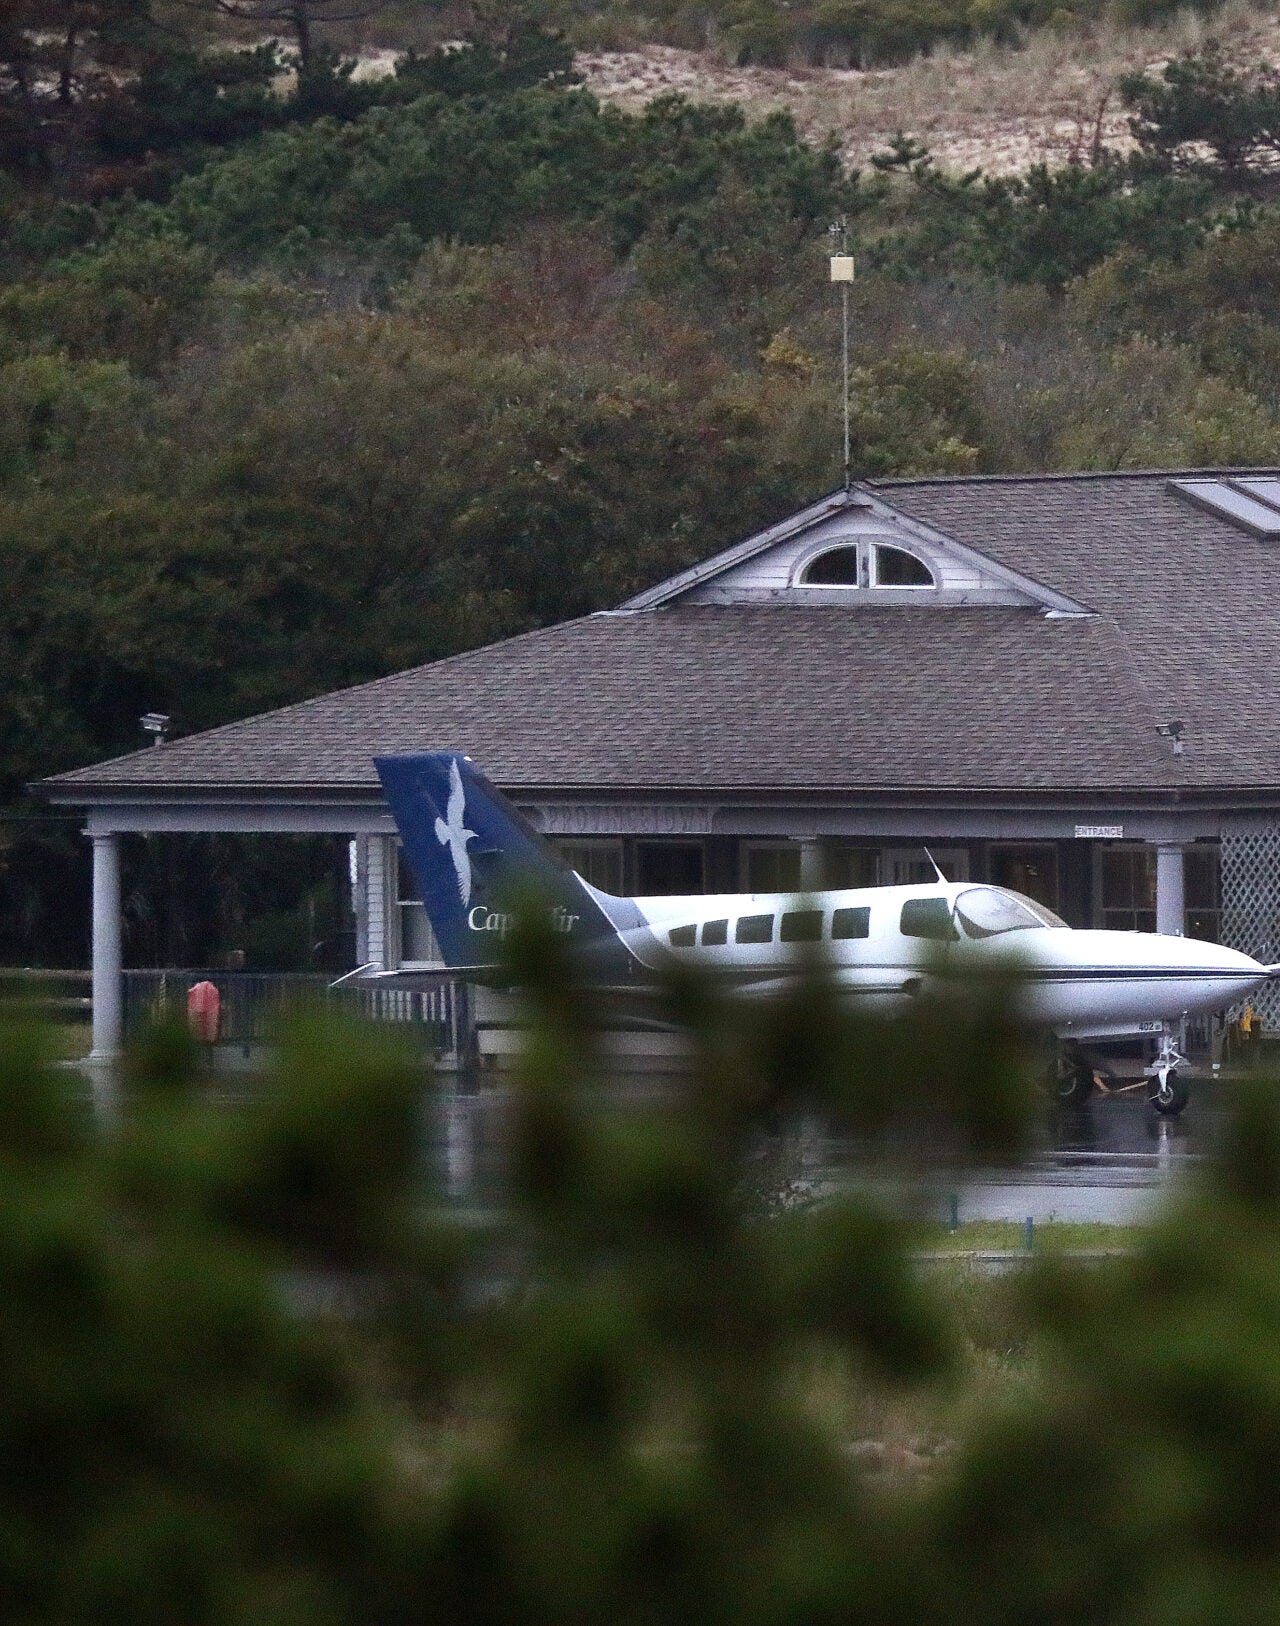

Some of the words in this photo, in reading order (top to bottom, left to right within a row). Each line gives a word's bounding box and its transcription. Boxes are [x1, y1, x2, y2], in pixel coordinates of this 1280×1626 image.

[1075, 827, 1122, 836] ENTRANCE
[468, 906, 516, 940] Cap
[1139, 1022, 1154, 1031] 402
